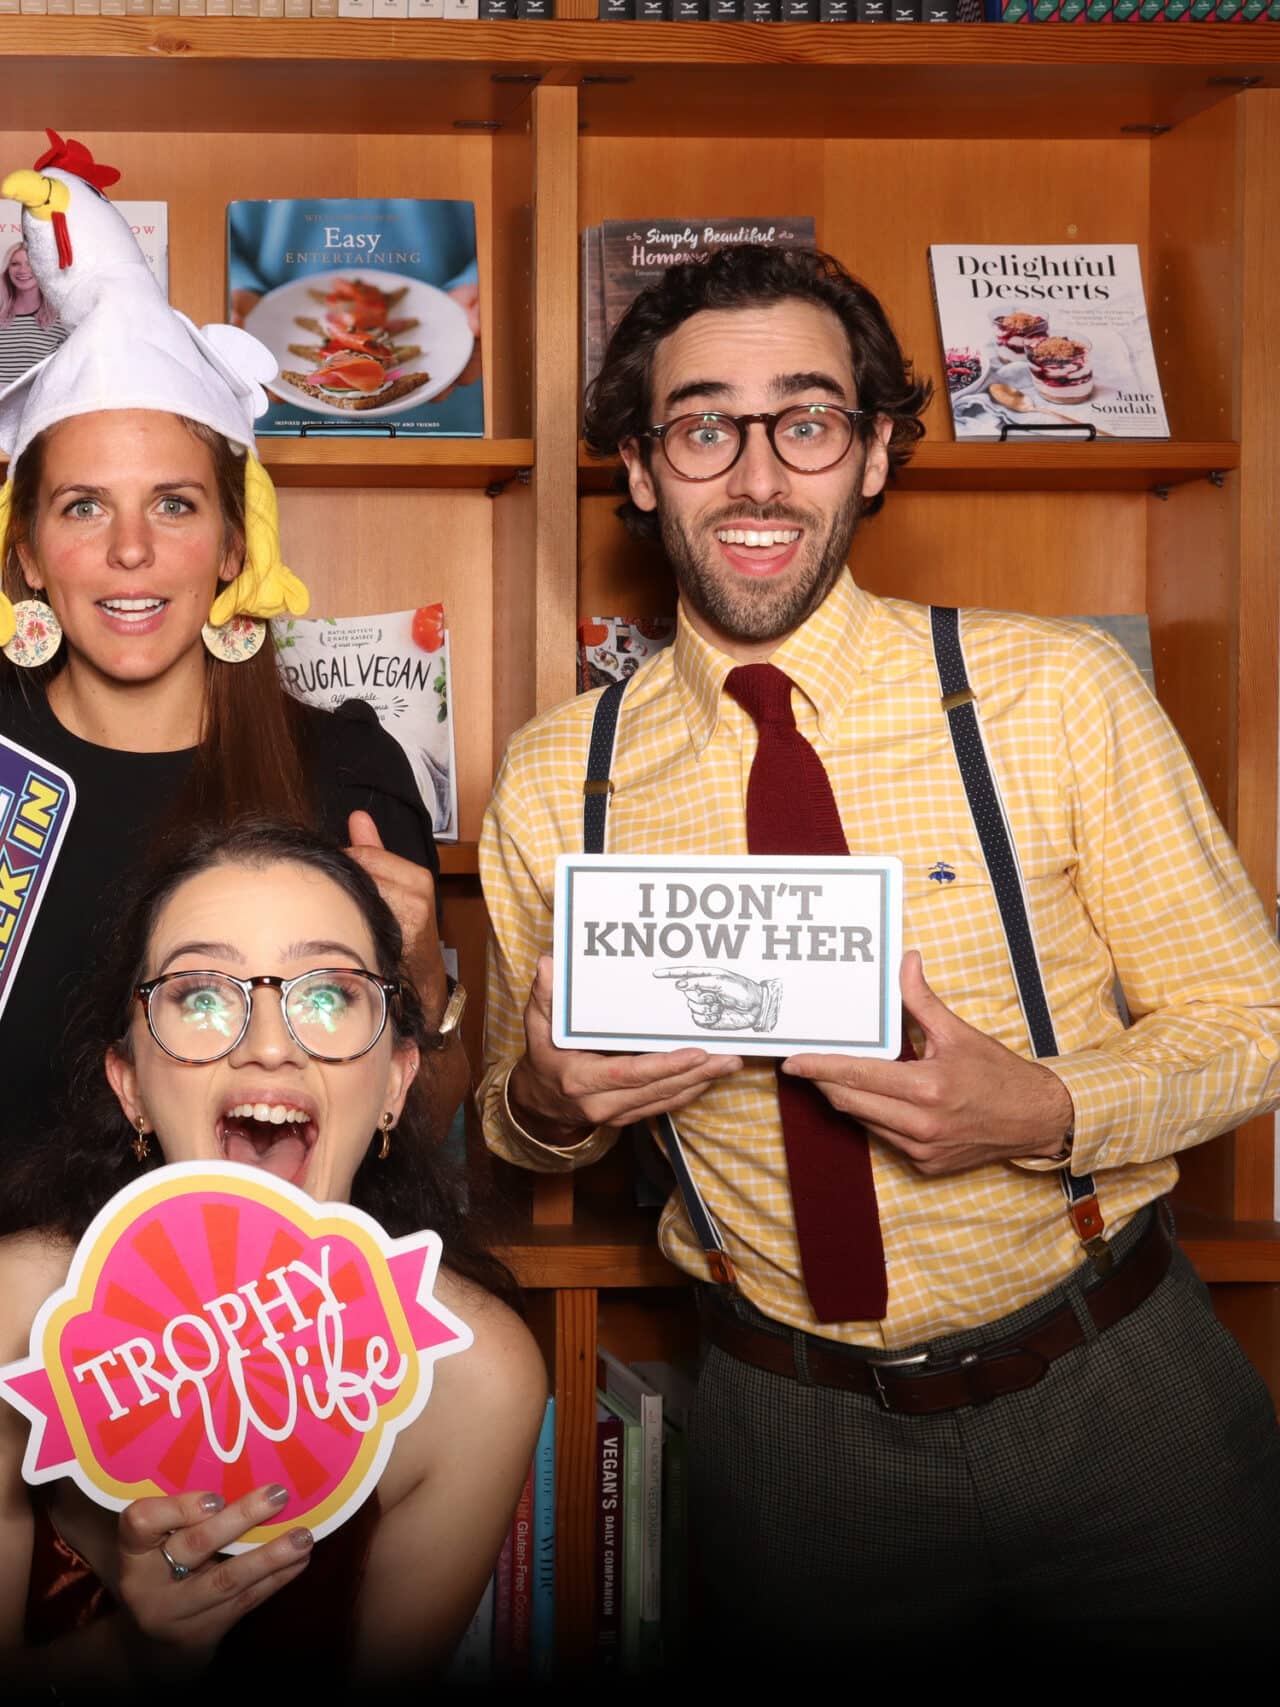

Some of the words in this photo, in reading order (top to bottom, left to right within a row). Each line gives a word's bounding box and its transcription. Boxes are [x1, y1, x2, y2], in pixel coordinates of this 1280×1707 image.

[323, 227, 383, 254] Easy
[646, 228, 699, 249] Simply
[703, 226, 775, 244] Beautiful
[285, 253, 421, 264] ENTERTAINING
[955, 253, 1117, 282] Delightful
[970, 278, 1111, 300] Desserts
[1091, 403, 1157, 415] Soudah
[1116, 389, 1155, 401] Jane
[356, 654, 432, 692] VEGAN
[7, 772, 65, 858] IN
[638, 883, 655, 919] I
[666, 883, 822, 921] DON'T
[583, 922, 750, 960] KNOW
[762, 925, 874, 962] HER
[73, 1245, 346, 1421] TROPHY
[168, 1300, 408, 1463] Wife
[543, 1447, 553, 1497] GUIDE
[602, 1437, 618, 1510] VEGAN'S
[543, 1505, 553, 1526] TO
[604, 1516, 616, 1548] DAILY
[516, 1520, 529, 1592] Gluten-Free
[603, 1551, 615, 1616] COMPANION
